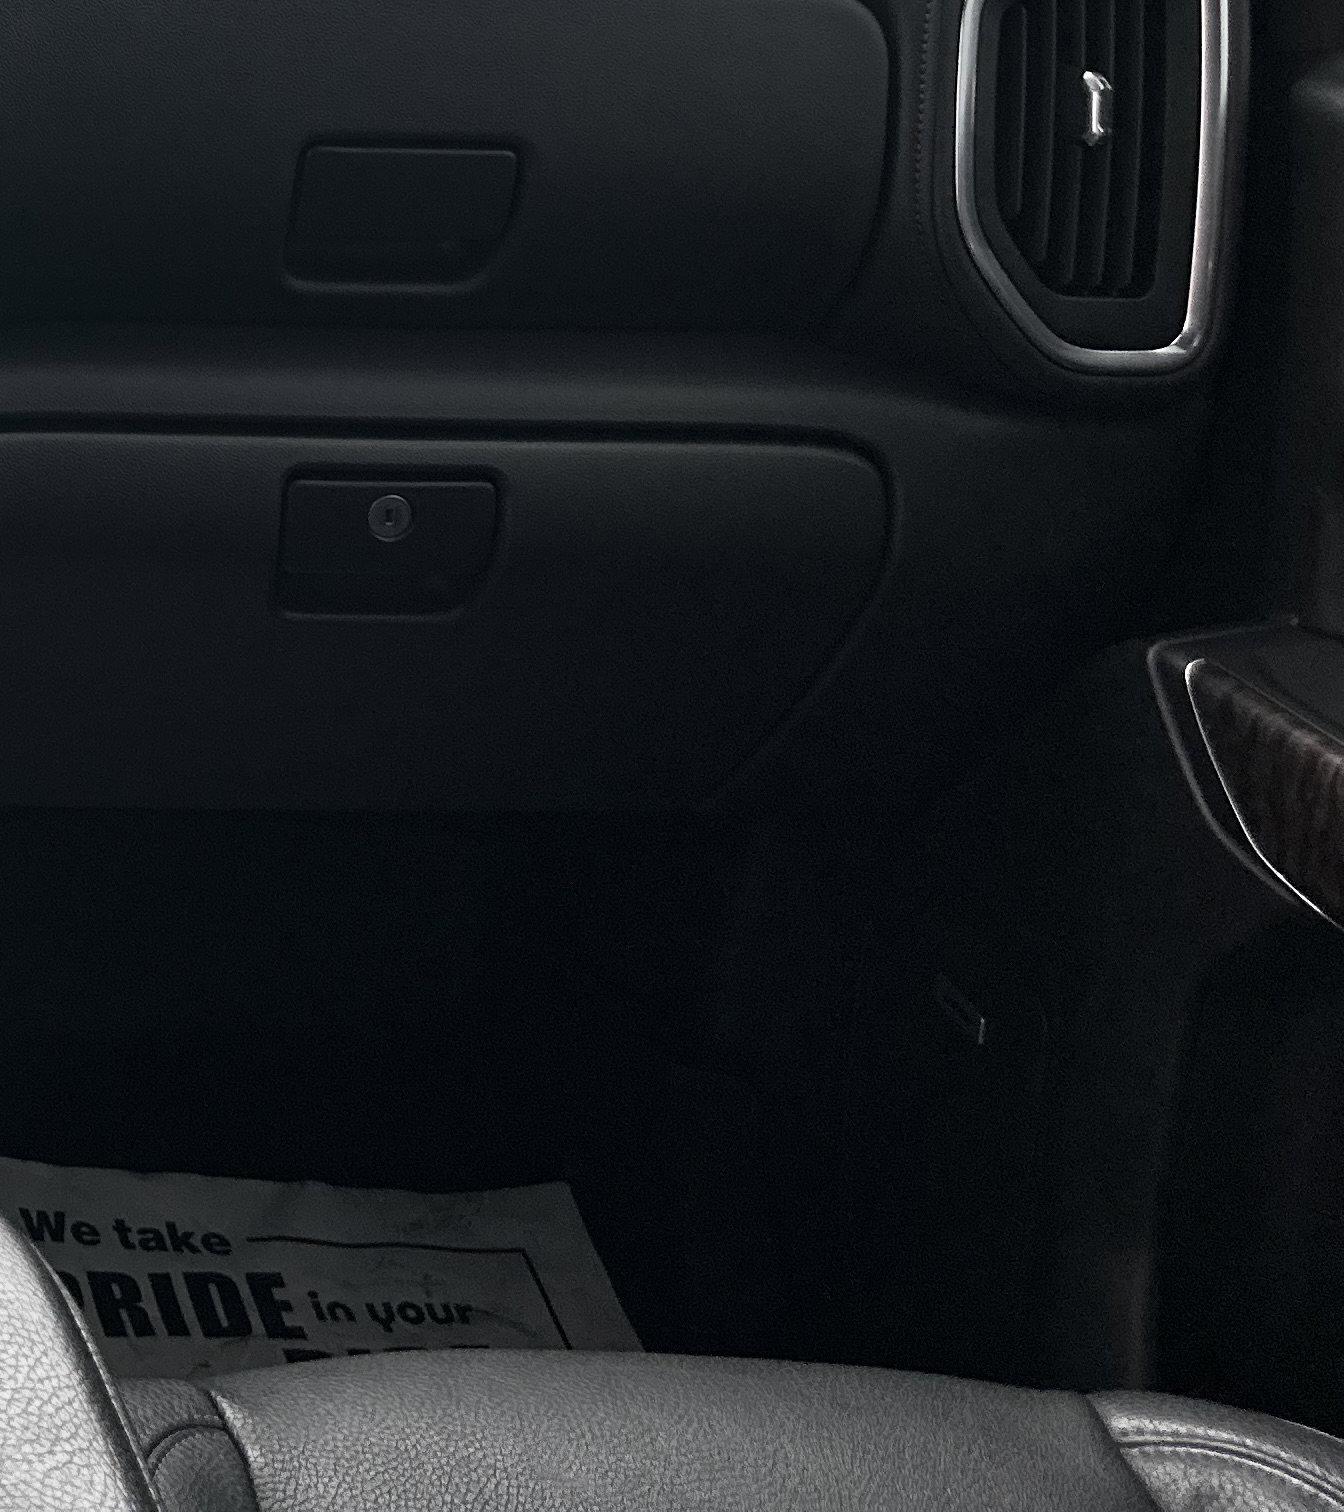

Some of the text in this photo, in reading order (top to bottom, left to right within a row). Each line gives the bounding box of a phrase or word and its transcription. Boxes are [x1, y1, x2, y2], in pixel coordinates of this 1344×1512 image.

[18, 1207, 233, 1256] We take
[307, 1290, 358, 1323] in
[364, 1300, 474, 1334] your
